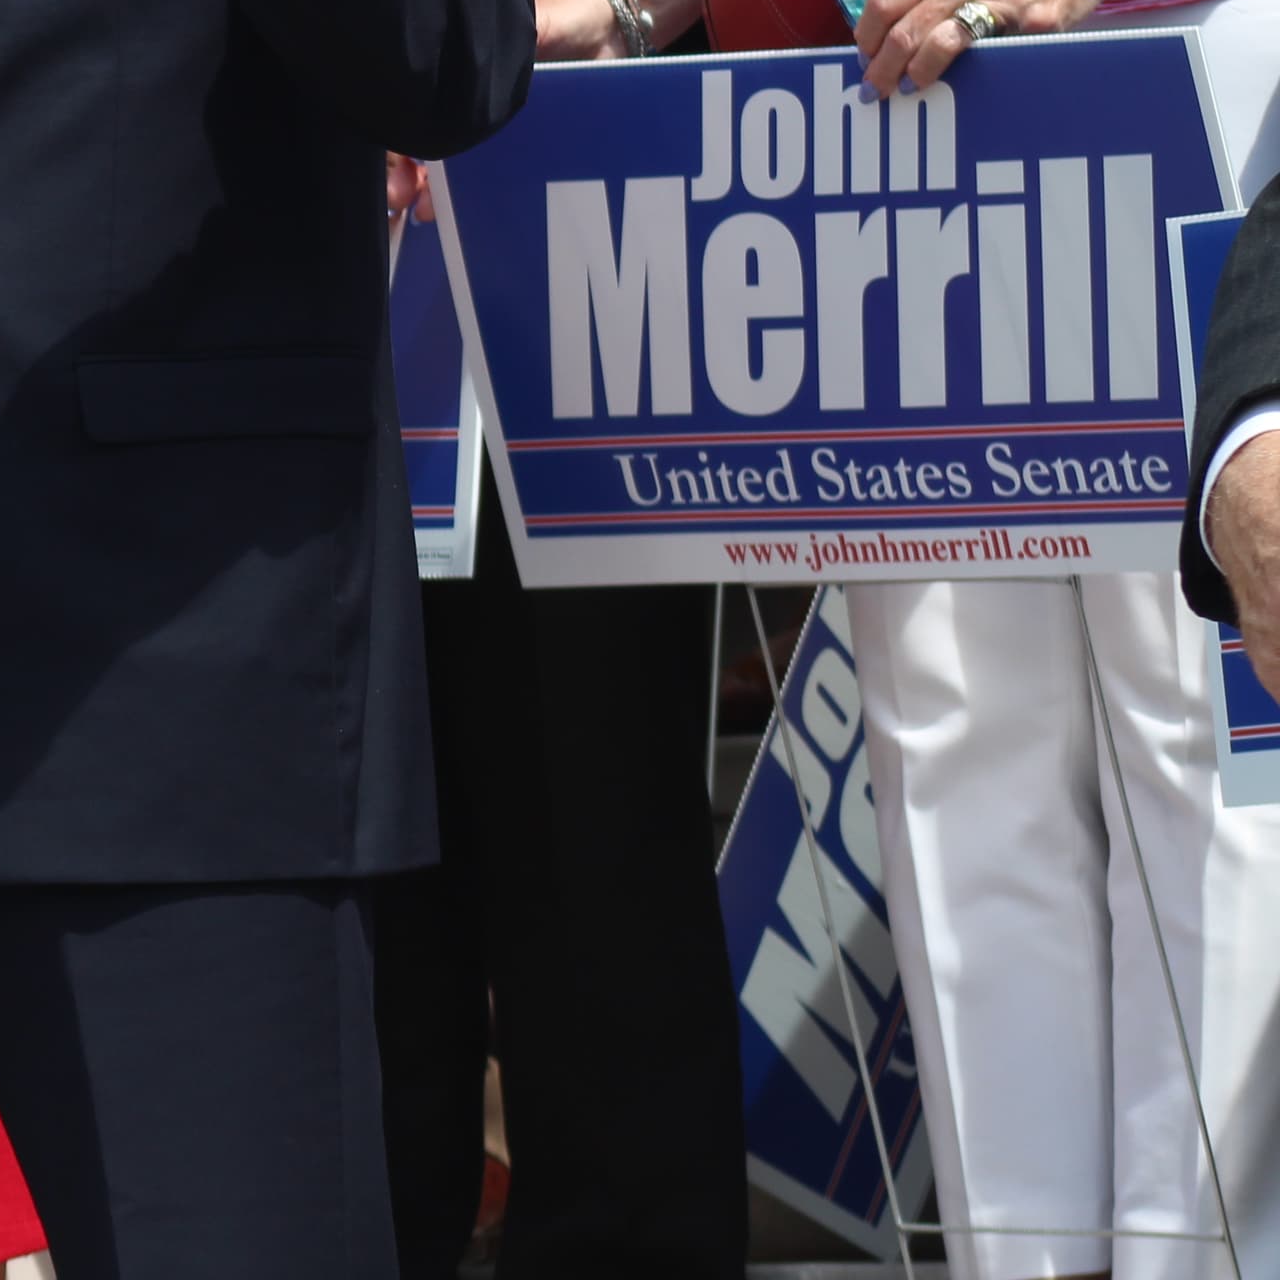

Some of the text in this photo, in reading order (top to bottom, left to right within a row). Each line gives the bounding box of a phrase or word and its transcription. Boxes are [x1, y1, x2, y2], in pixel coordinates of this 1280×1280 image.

[691, 63, 957, 202] John
[545, 153, 1160, 419] Merrill
[614, 442, 1173, 507] United States Senate
[724, 529, 1092, 572] www.johnhmerrill.com
